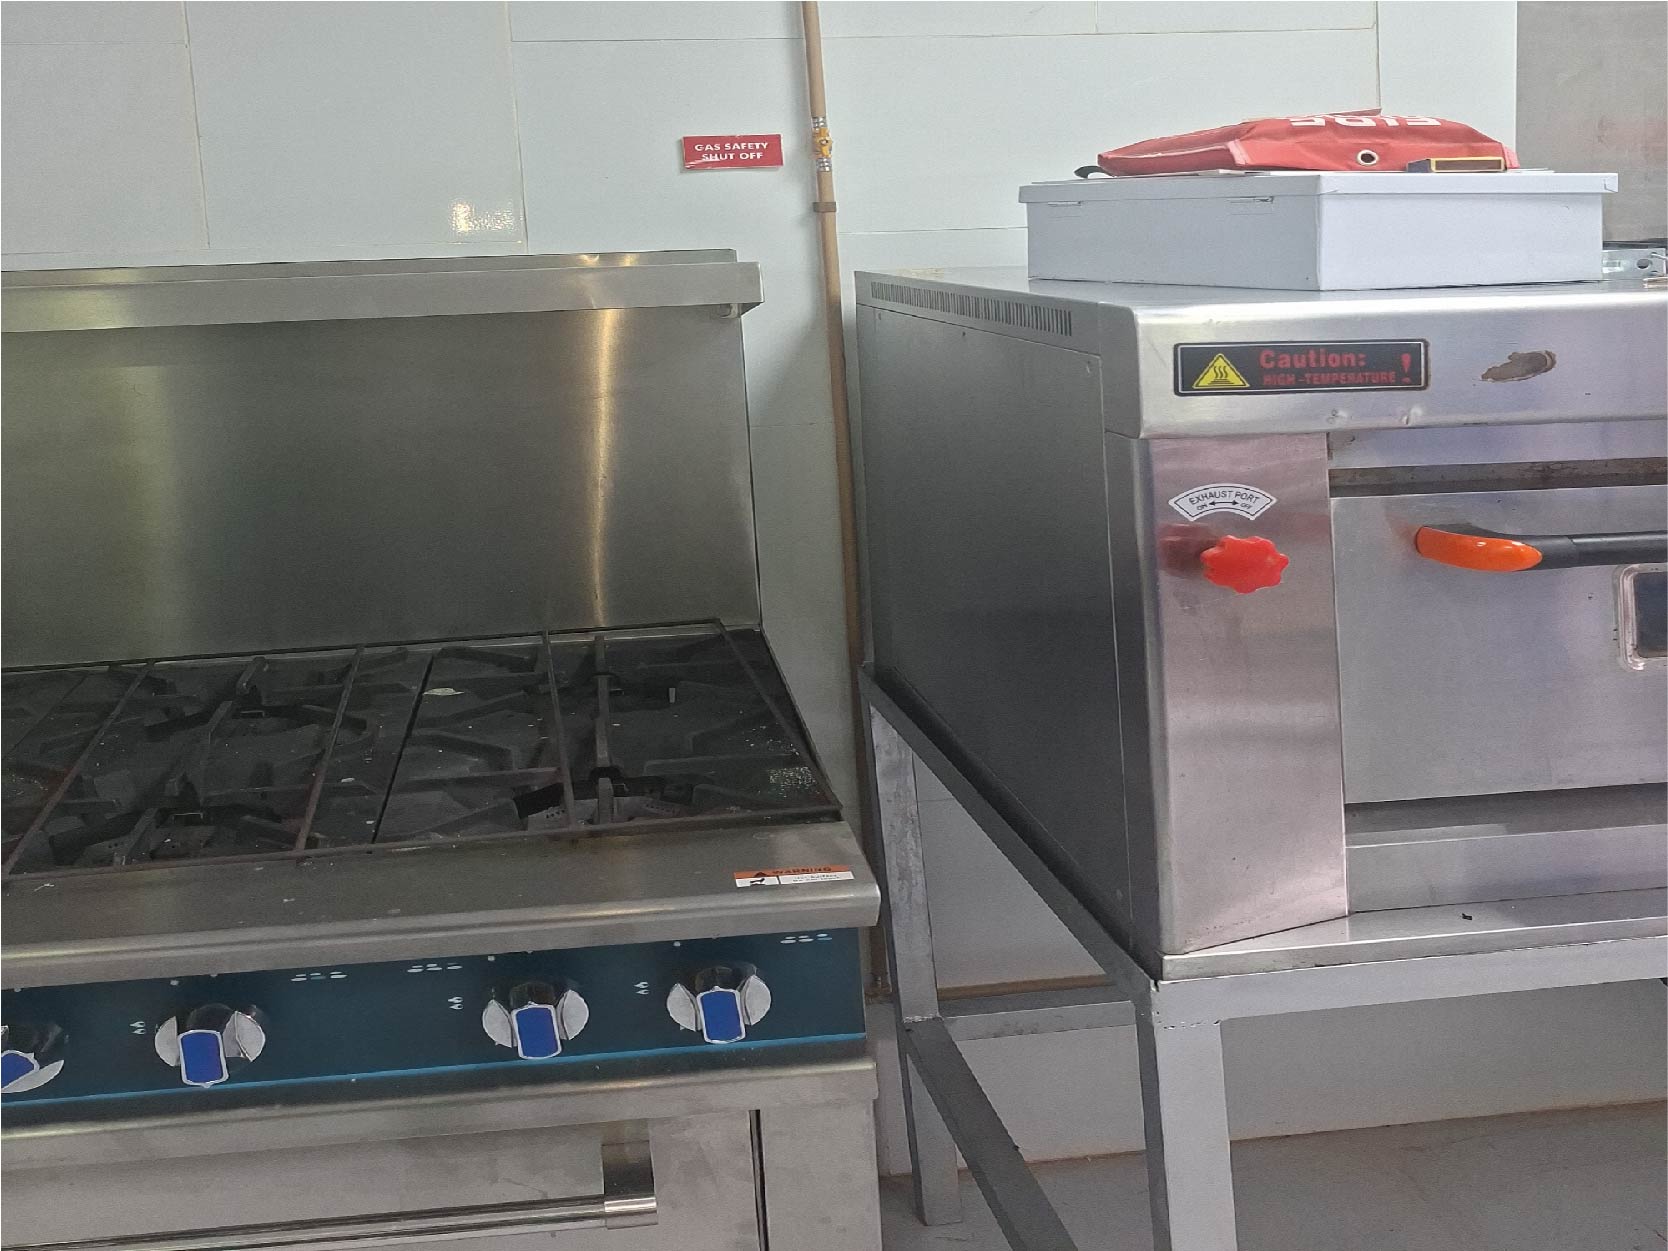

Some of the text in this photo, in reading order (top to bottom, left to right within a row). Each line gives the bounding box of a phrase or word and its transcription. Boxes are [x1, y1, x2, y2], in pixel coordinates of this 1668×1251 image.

[694, 142, 769, 152] GAS SAFETY
[702, 152, 764, 161] SHUT OFF
[1259, 349, 1367, 369] Caution:
[1188, 490, 1260, 505] EXHAUST PORT
[1196, 502, 1254, 511] ON OFF
